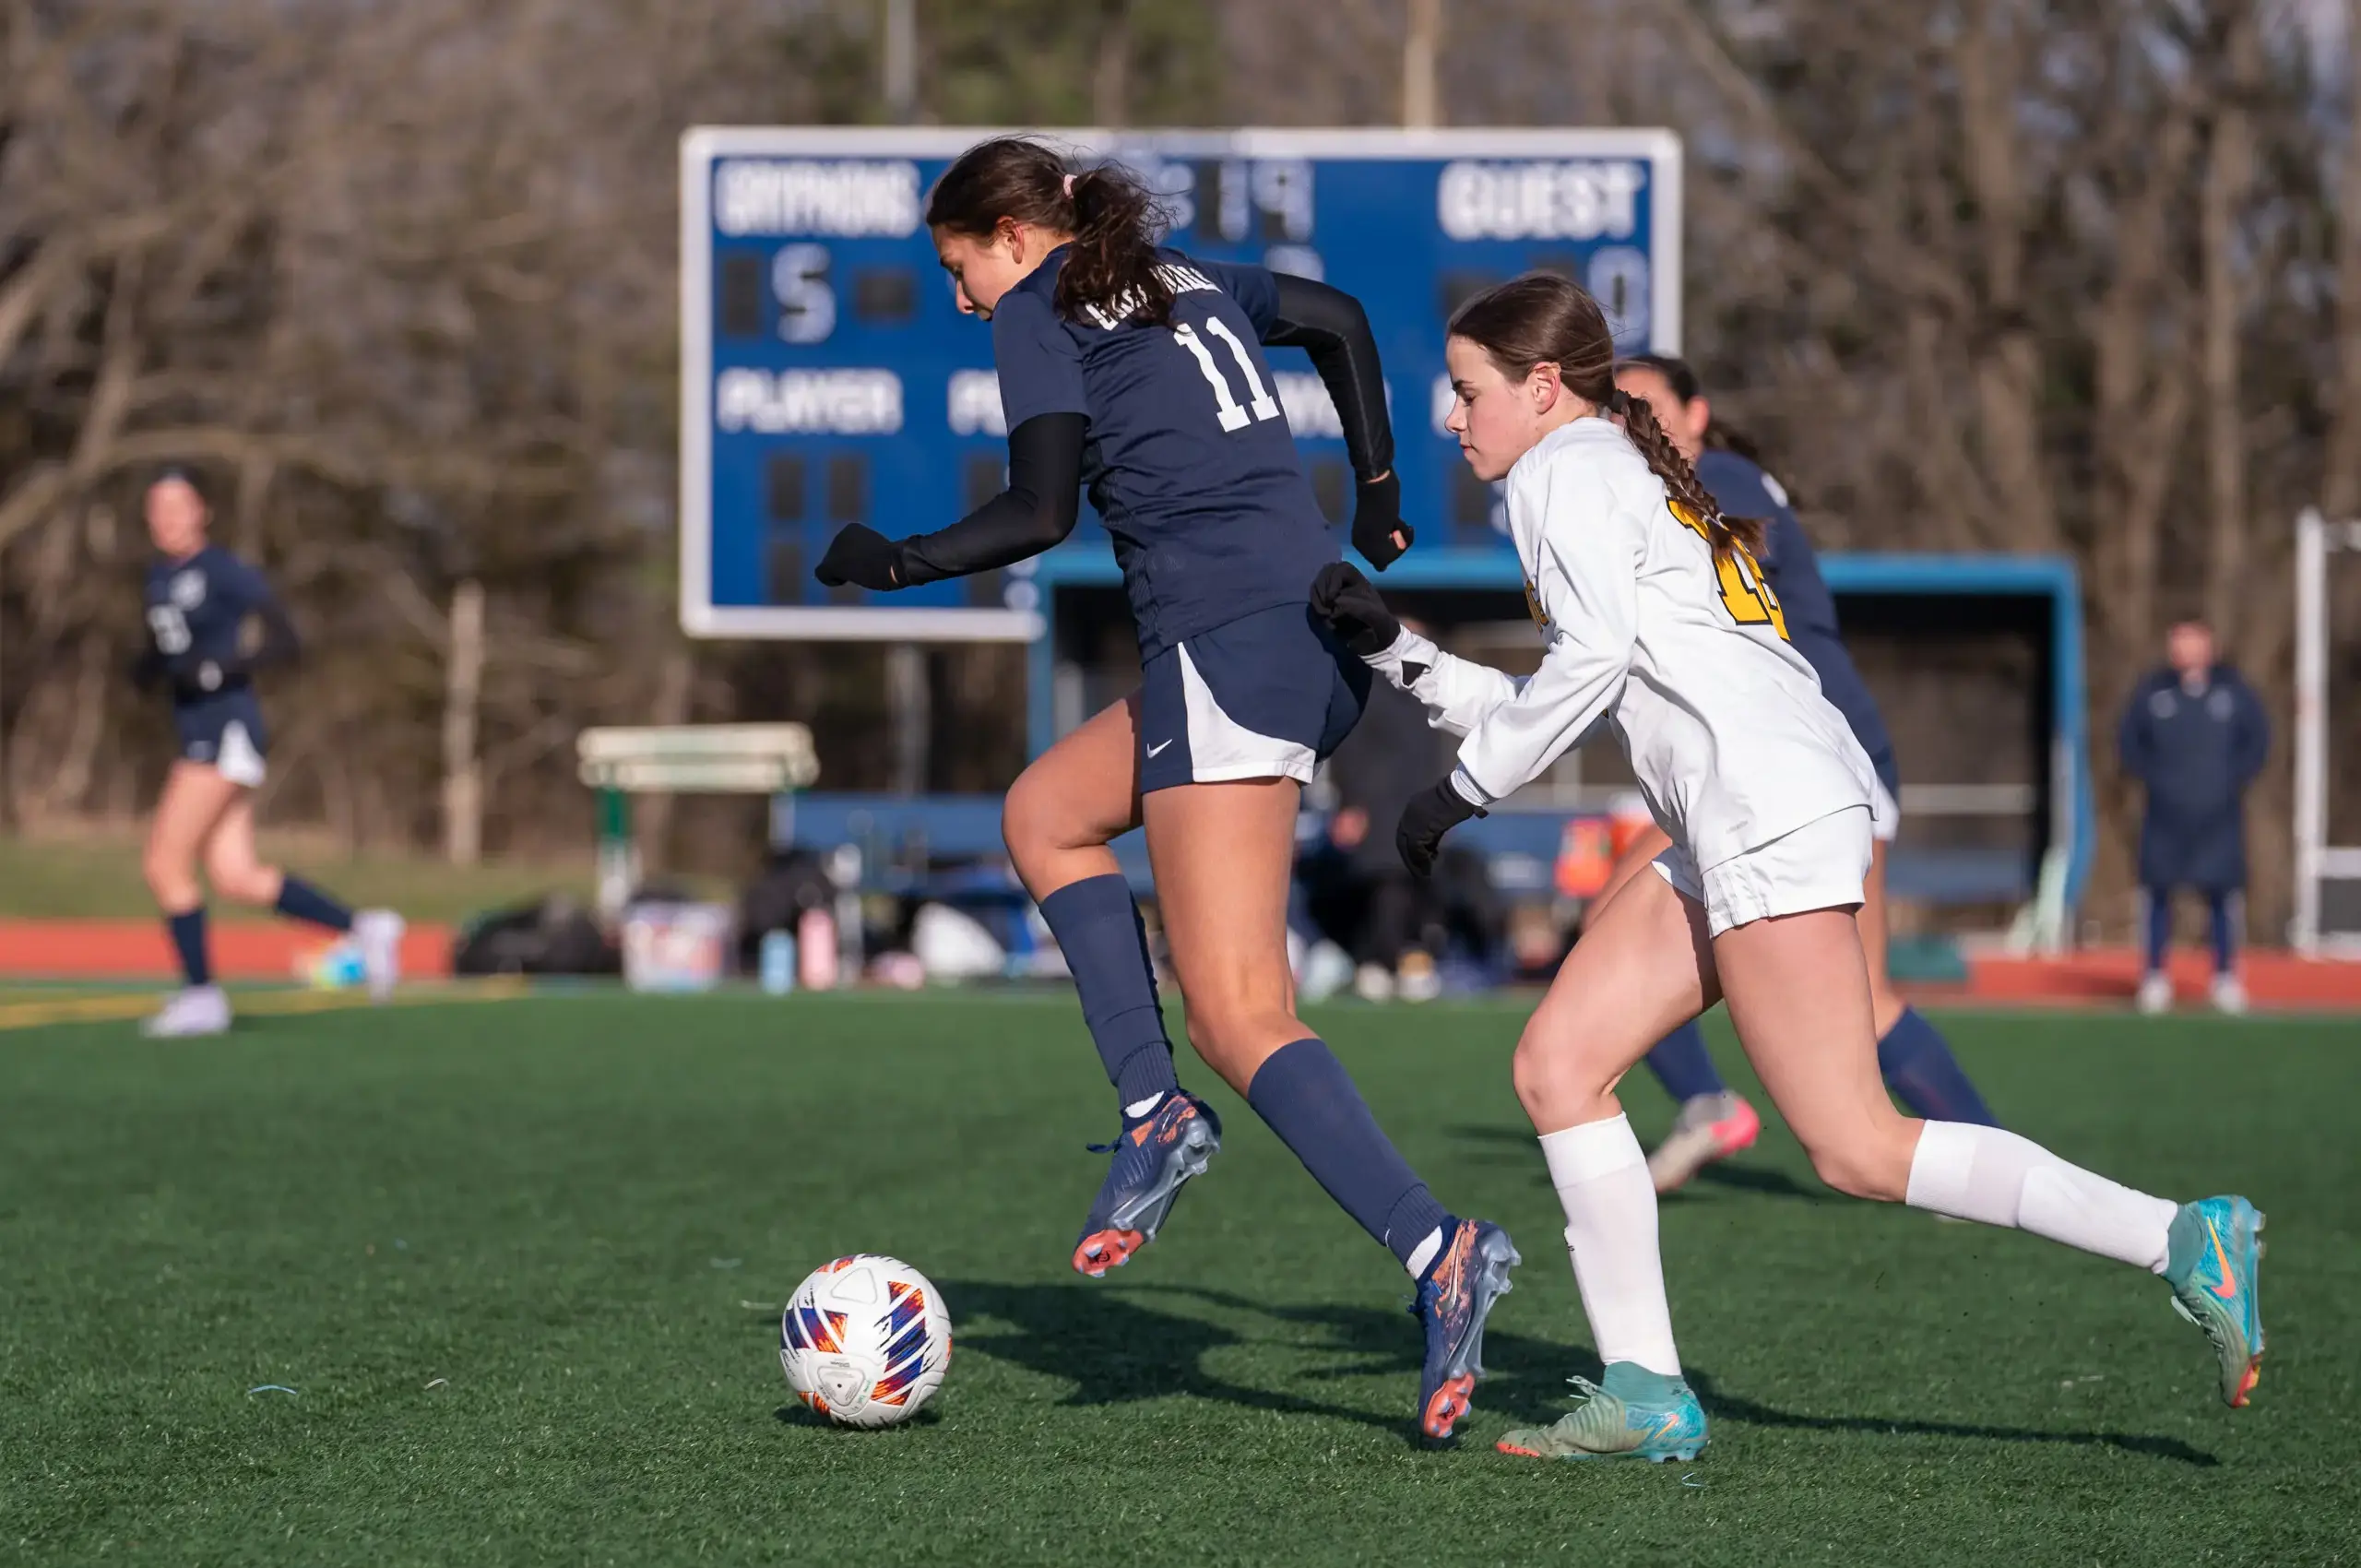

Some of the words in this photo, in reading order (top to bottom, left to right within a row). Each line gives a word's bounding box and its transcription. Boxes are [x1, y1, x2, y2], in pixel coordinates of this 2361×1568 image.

[1439, 160, 1643, 240] GUEST
[772, 244, 836, 344] 5
[718, 368, 902, 434] PLAYER
[1174, 315, 1280, 433] 11
